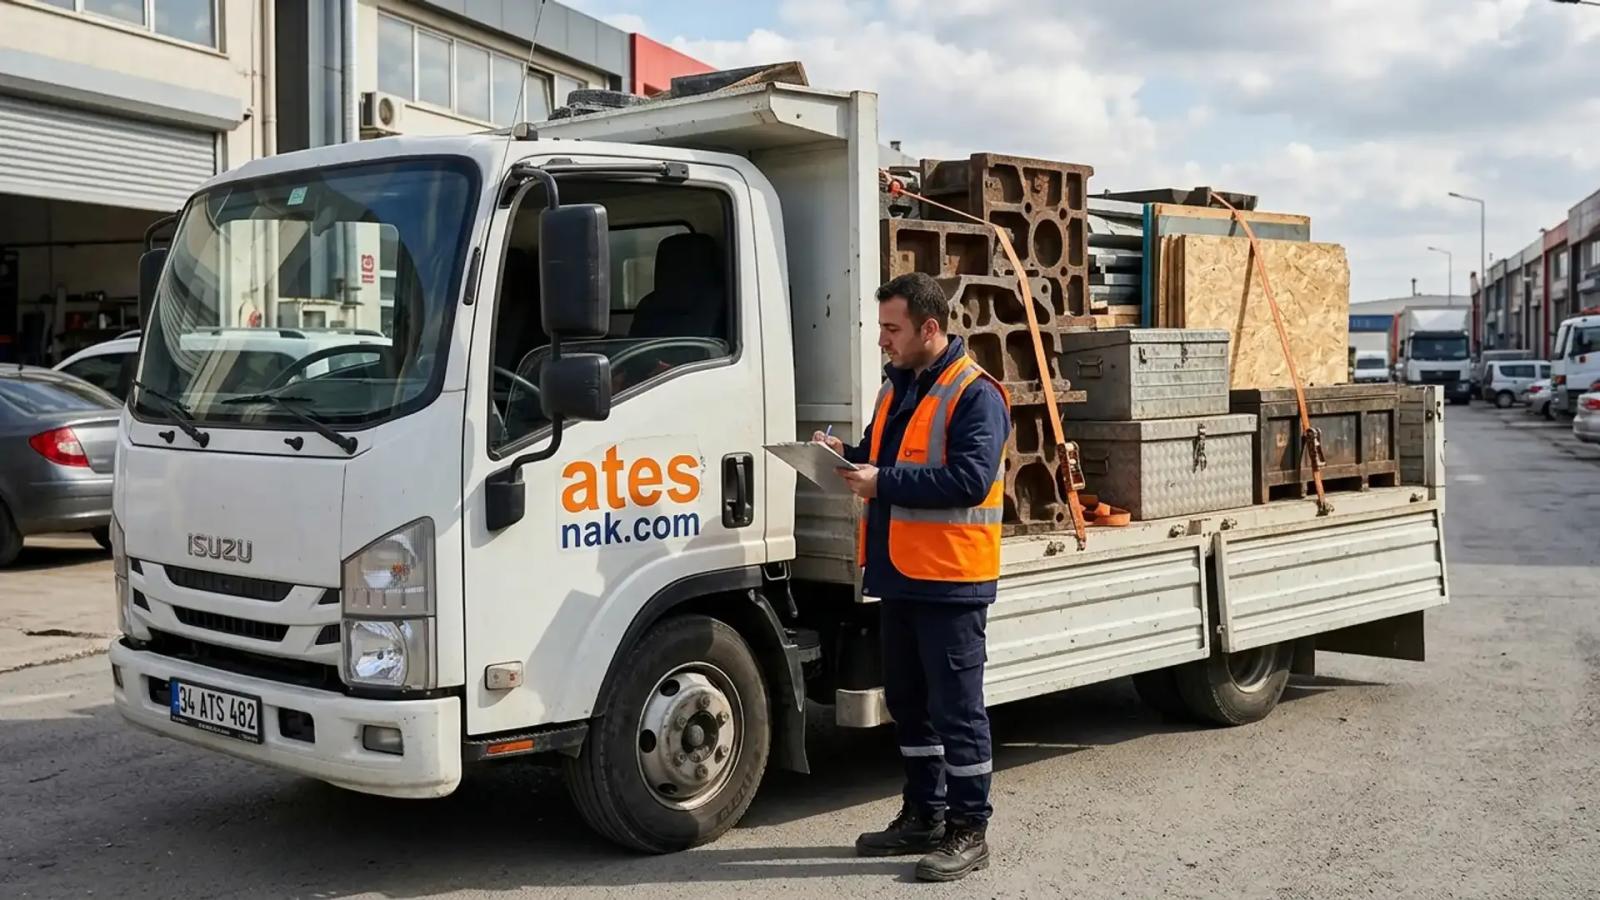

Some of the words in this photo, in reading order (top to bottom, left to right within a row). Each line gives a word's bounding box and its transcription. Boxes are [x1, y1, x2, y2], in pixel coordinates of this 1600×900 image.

[562, 445, 700, 513] ates
[187, 534, 252, 563] ISUZU
[562, 512, 699, 549] nak.com
[180, 686, 195, 715] 34
[200, 692, 224, 722] ATS
[230, 698, 256, 730] 482
